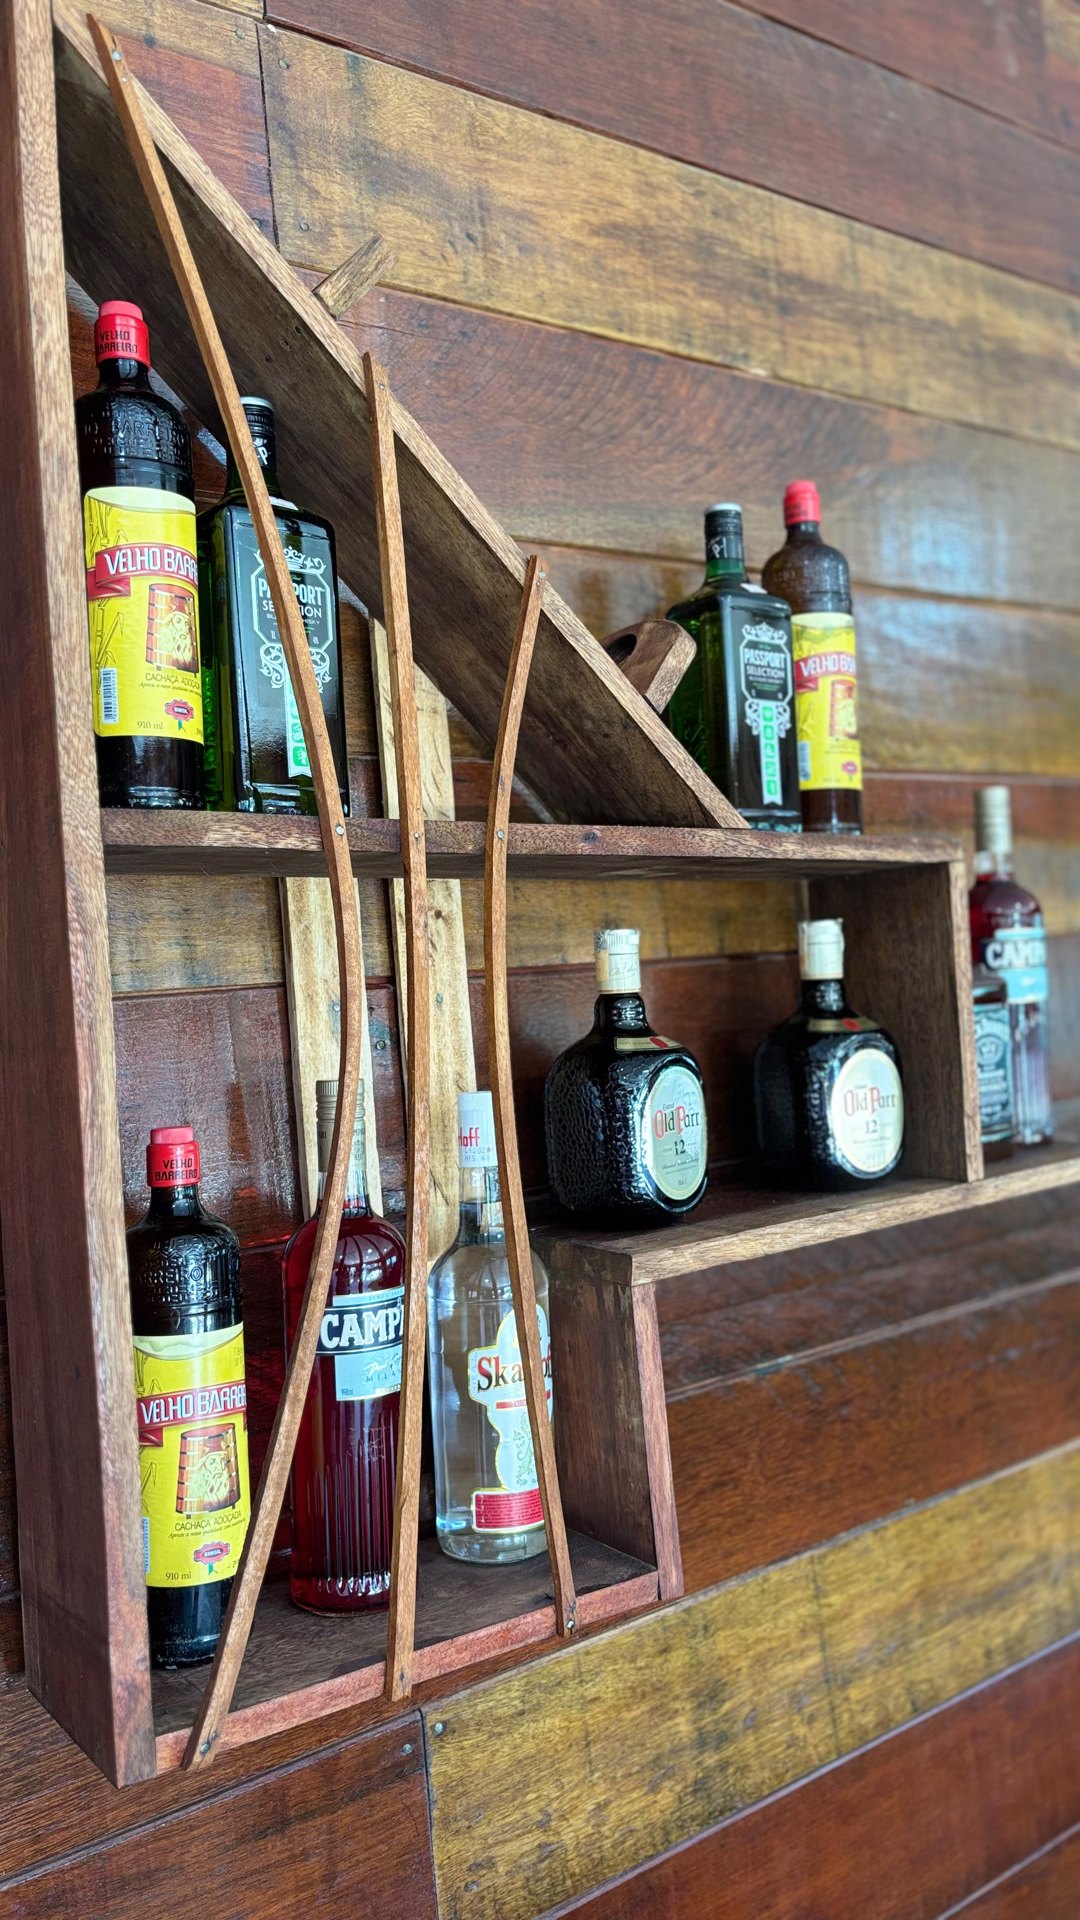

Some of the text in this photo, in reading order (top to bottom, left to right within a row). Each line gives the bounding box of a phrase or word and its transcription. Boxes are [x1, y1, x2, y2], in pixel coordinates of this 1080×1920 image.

[100, 330, 130, 341] VELHO
[99, 342, 138, 355] ARREIRO
[104, 547, 198, 585] VELHO BARR
[258, 577, 322, 606] PPORT
[262, 600, 322, 618] SEION
[800, 654, 839, 677] VELHO
[136, 720, 164, 730] 910 ml
[844, 1086, 897, 1117] Old Parr
[653, 1105, 700, 1139] Old Parr
[864, 1119, 878, 1135] 12
[674, 1139, 686, 1156] 12
[162, 1157, 193, 1170] VELHO
[155, 1168, 198, 1181] BARREIRO
[320, 1304, 404, 1349] CAMP
[365, 1369, 401, 1383] MILA
[141, 1393, 195, 1425] VELHO
[174, 1519, 212, 1533] CACHAÇA
[165, 1571, 192, 1581] 910 ml
